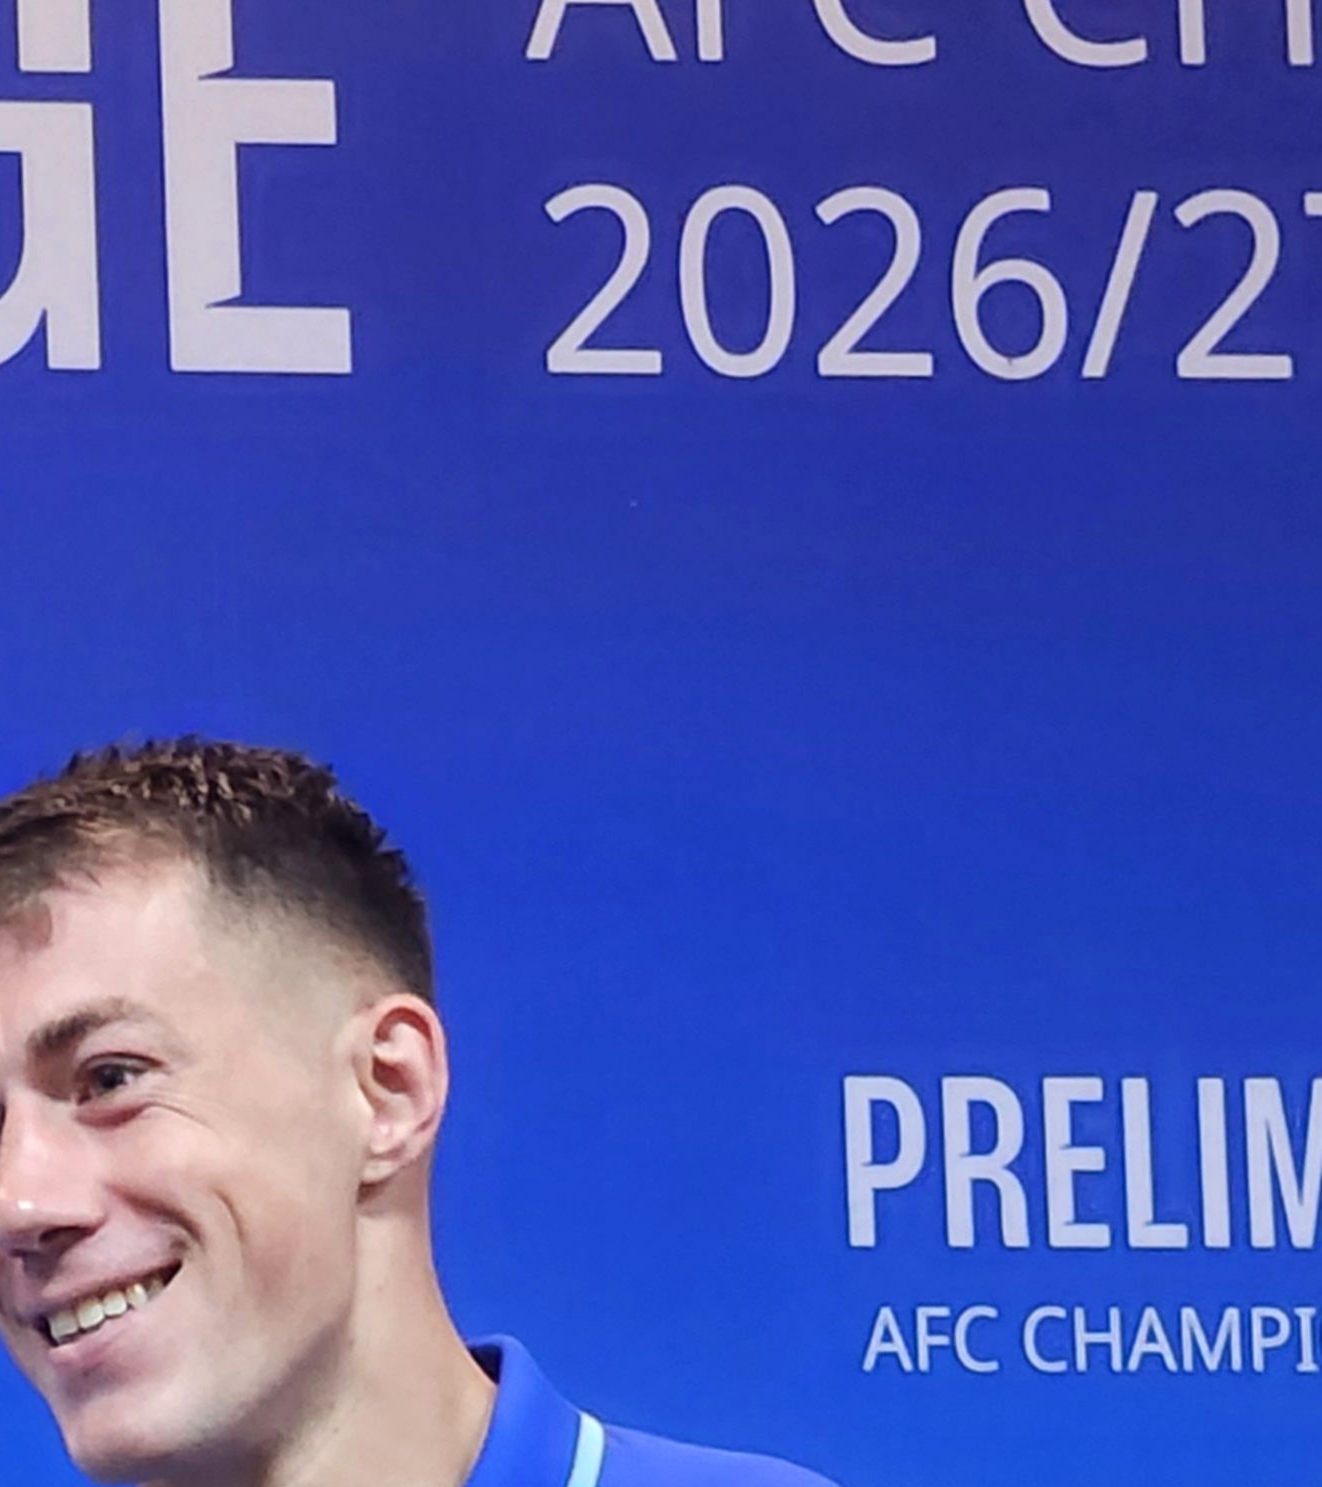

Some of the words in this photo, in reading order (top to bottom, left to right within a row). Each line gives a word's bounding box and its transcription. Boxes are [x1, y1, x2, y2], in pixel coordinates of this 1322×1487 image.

[543, 184, 1322, 380] 2026/2
[862, 1305, 1000, 1373] AFC
[1023, 1305, 1320, 1374] CHAMPI
